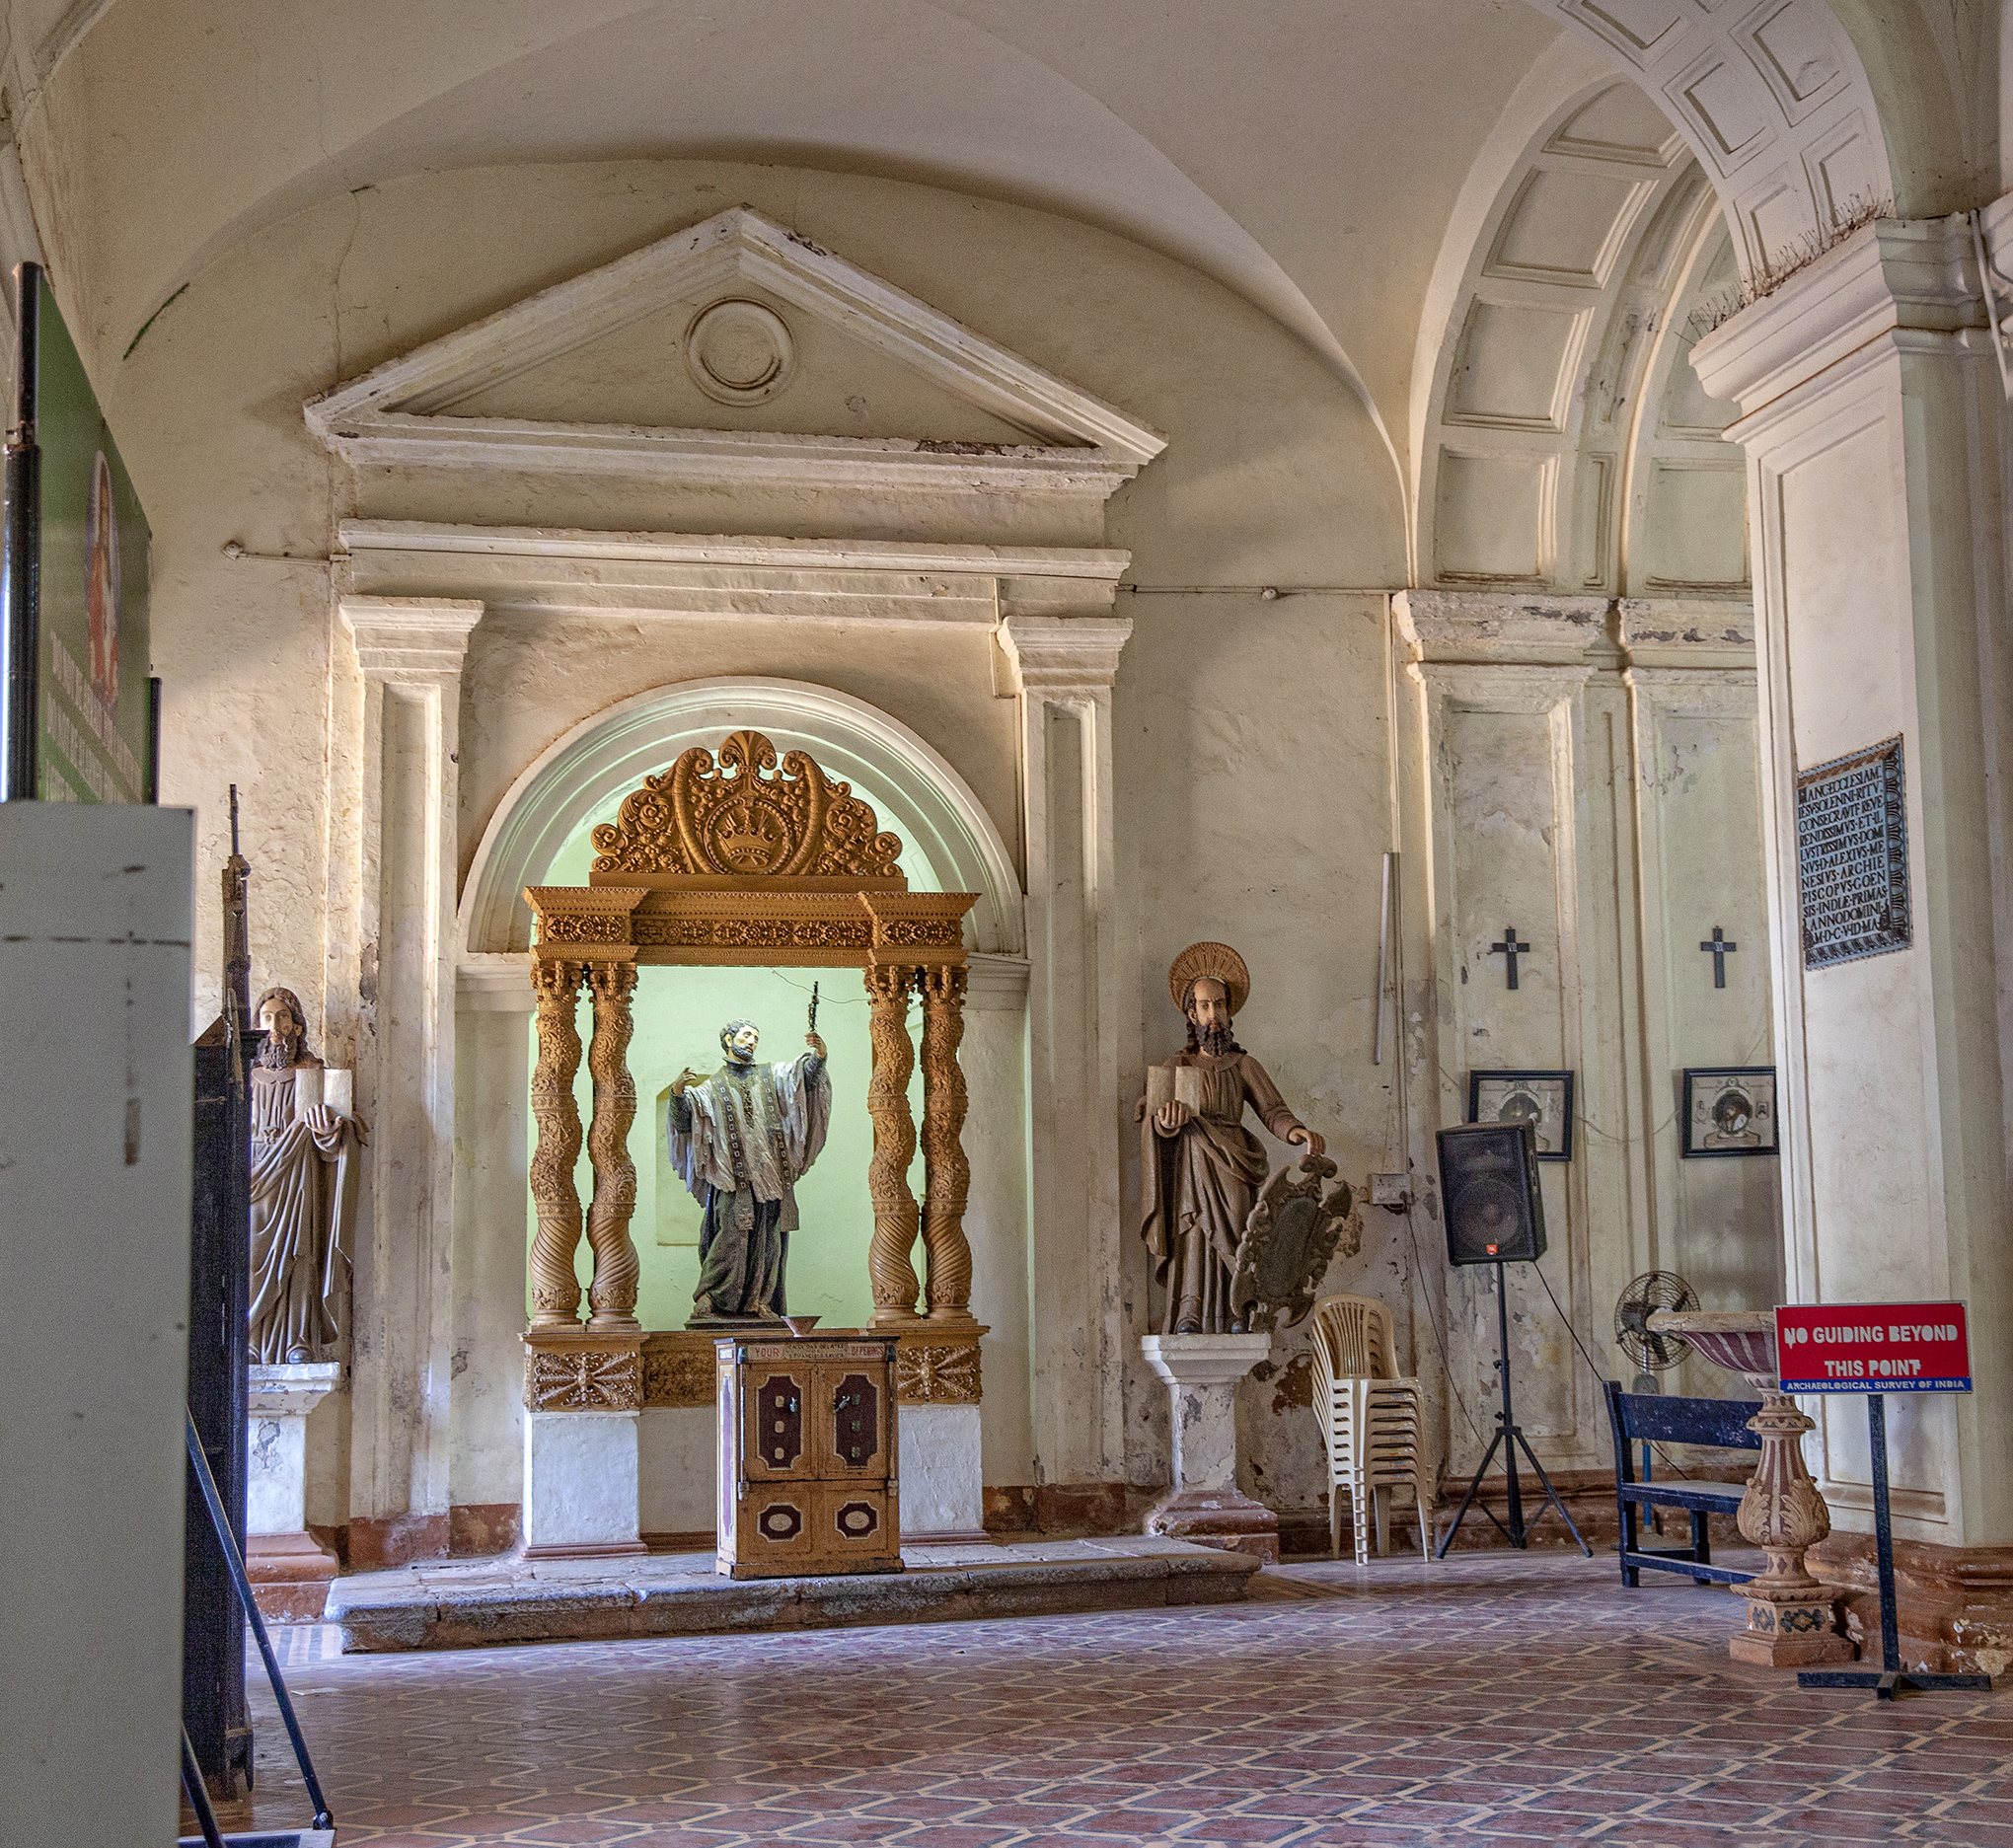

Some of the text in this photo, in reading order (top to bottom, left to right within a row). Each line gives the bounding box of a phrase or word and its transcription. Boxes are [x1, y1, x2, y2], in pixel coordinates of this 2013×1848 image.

[1784, 1324, 1958, 1344] NO GUIDING BEYOND
[755, 1347, 780, 1358] YOUR
[1825, 1359, 1921, 1376] THIS POINT
[1786, 1381, 1872, 1390] ARCHAEOLOGICAL
[1875, 1380, 1916, 1389] SURVEY
[1935, 1379, 1965, 1388] INDIA
